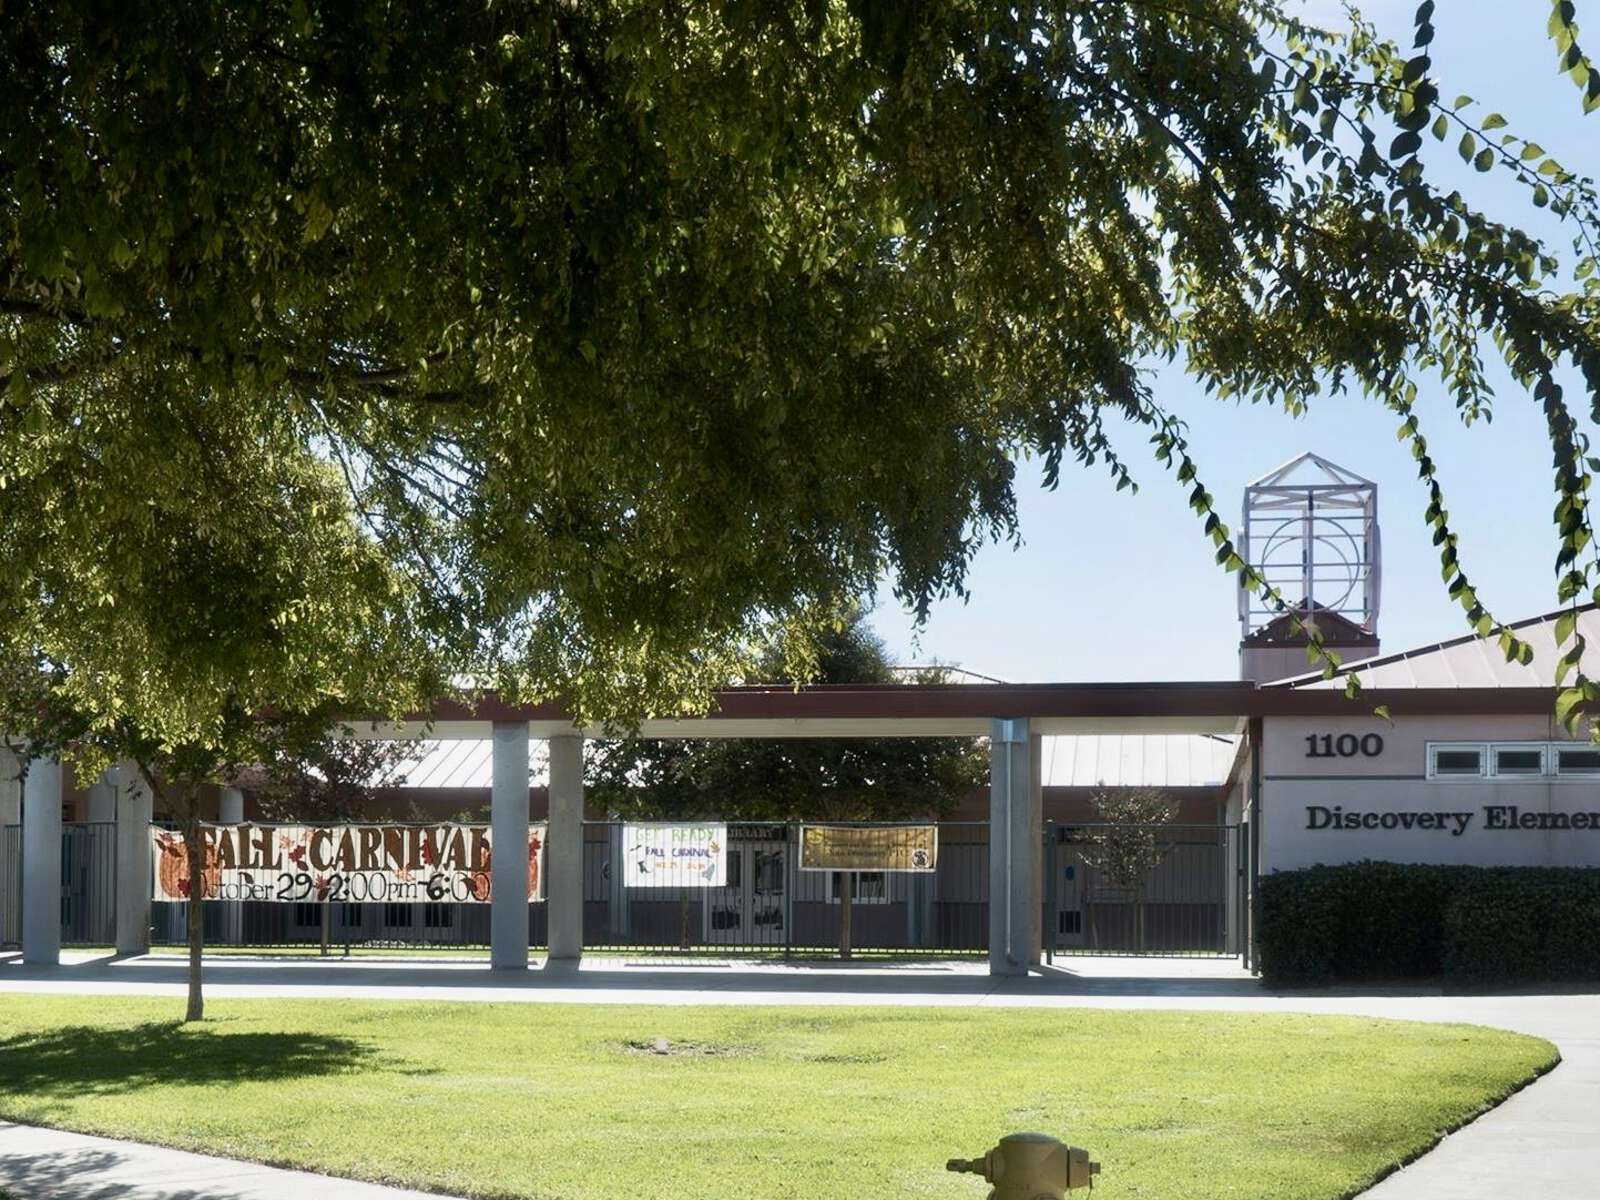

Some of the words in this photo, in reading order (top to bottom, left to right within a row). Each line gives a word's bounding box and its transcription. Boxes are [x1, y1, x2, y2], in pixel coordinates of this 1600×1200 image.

[1305, 733, 1384, 758] 1100
[1305, 806, 1474, 836] Discovery
[200, 826, 282, 869] FALL
[309, 826, 492, 872] CARNIVAL
[277, 873, 312, 900] 29
